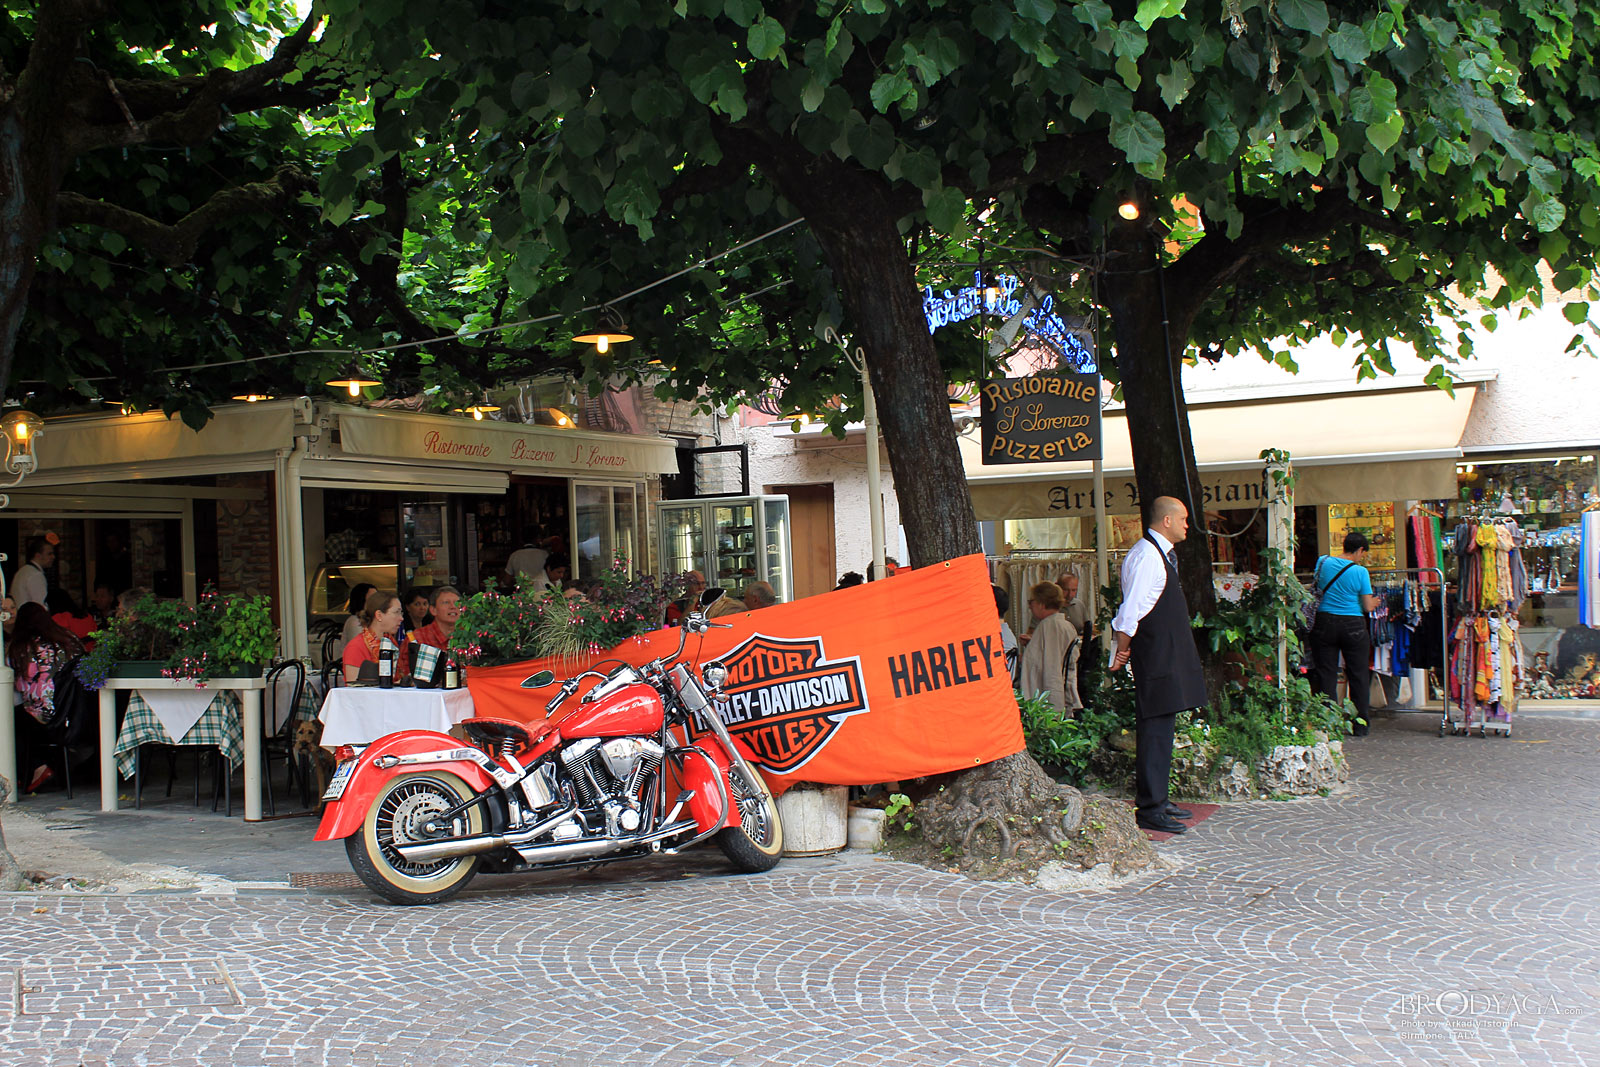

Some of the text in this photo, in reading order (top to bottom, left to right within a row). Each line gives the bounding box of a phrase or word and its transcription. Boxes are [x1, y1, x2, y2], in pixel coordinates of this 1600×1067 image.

[984, 377, 1096, 412] Ristorante
[1020, 403, 1090, 431] Lorenzo
[424, 430, 492, 457] Ristorante
[510, 439, 556, 462] Pizzeria
[586, 446, 627, 468] Lorenzo
[989, 432, 1092, 460] Pizzeria
[1047, 485, 1115, 511] Arte
[724, 647, 805, 687] MOTOR
[694, 673, 850, 731] HRLEY-DAVIDSON
